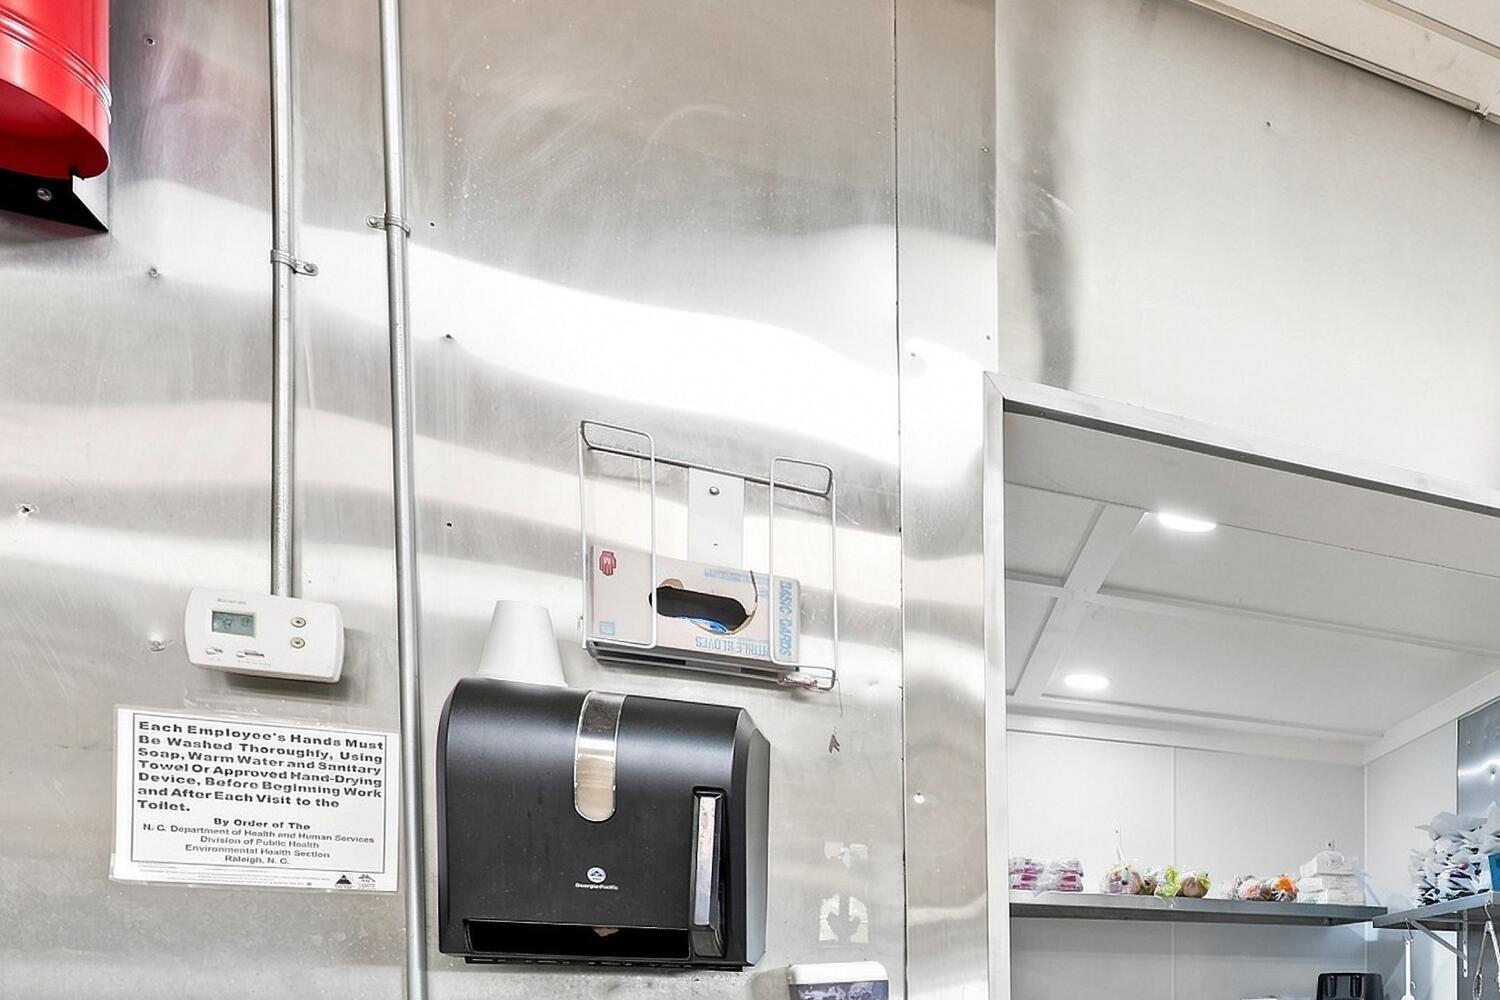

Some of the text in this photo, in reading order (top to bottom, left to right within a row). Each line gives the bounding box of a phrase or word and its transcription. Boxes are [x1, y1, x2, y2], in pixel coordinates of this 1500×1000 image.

[139, 721, 383, 750] Each Employee's Hands Must
[139, 735, 382, 765] Be Washed Thoroughly, Using
[138, 747, 381, 776] Soap, Warm Water and Sanitary
[138, 760, 382, 788] Towel Or Approved Hand-Drying
[139, 772, 382, 798] Device, Before Beginning Work
[137, 799, 190, 811] Toilet.
[138, 788, 340, 808] and After Each Visit to the
[214, 818, 229, 827] By
[233, 819, 268, 828] Order
[288, 822, 310, 830] The
[170, 825, 229, 835] Department
[244, 830, 276, 839] Health
[299, 832, 332, 842] Human
[334, 834, 375, 844] Services
[200, 835, 241, 845] Division
[256, 839, 286, 847] Public
[289, 840, 320, 849] Health
[185, 844, 330, 859] Environmental Health Section
